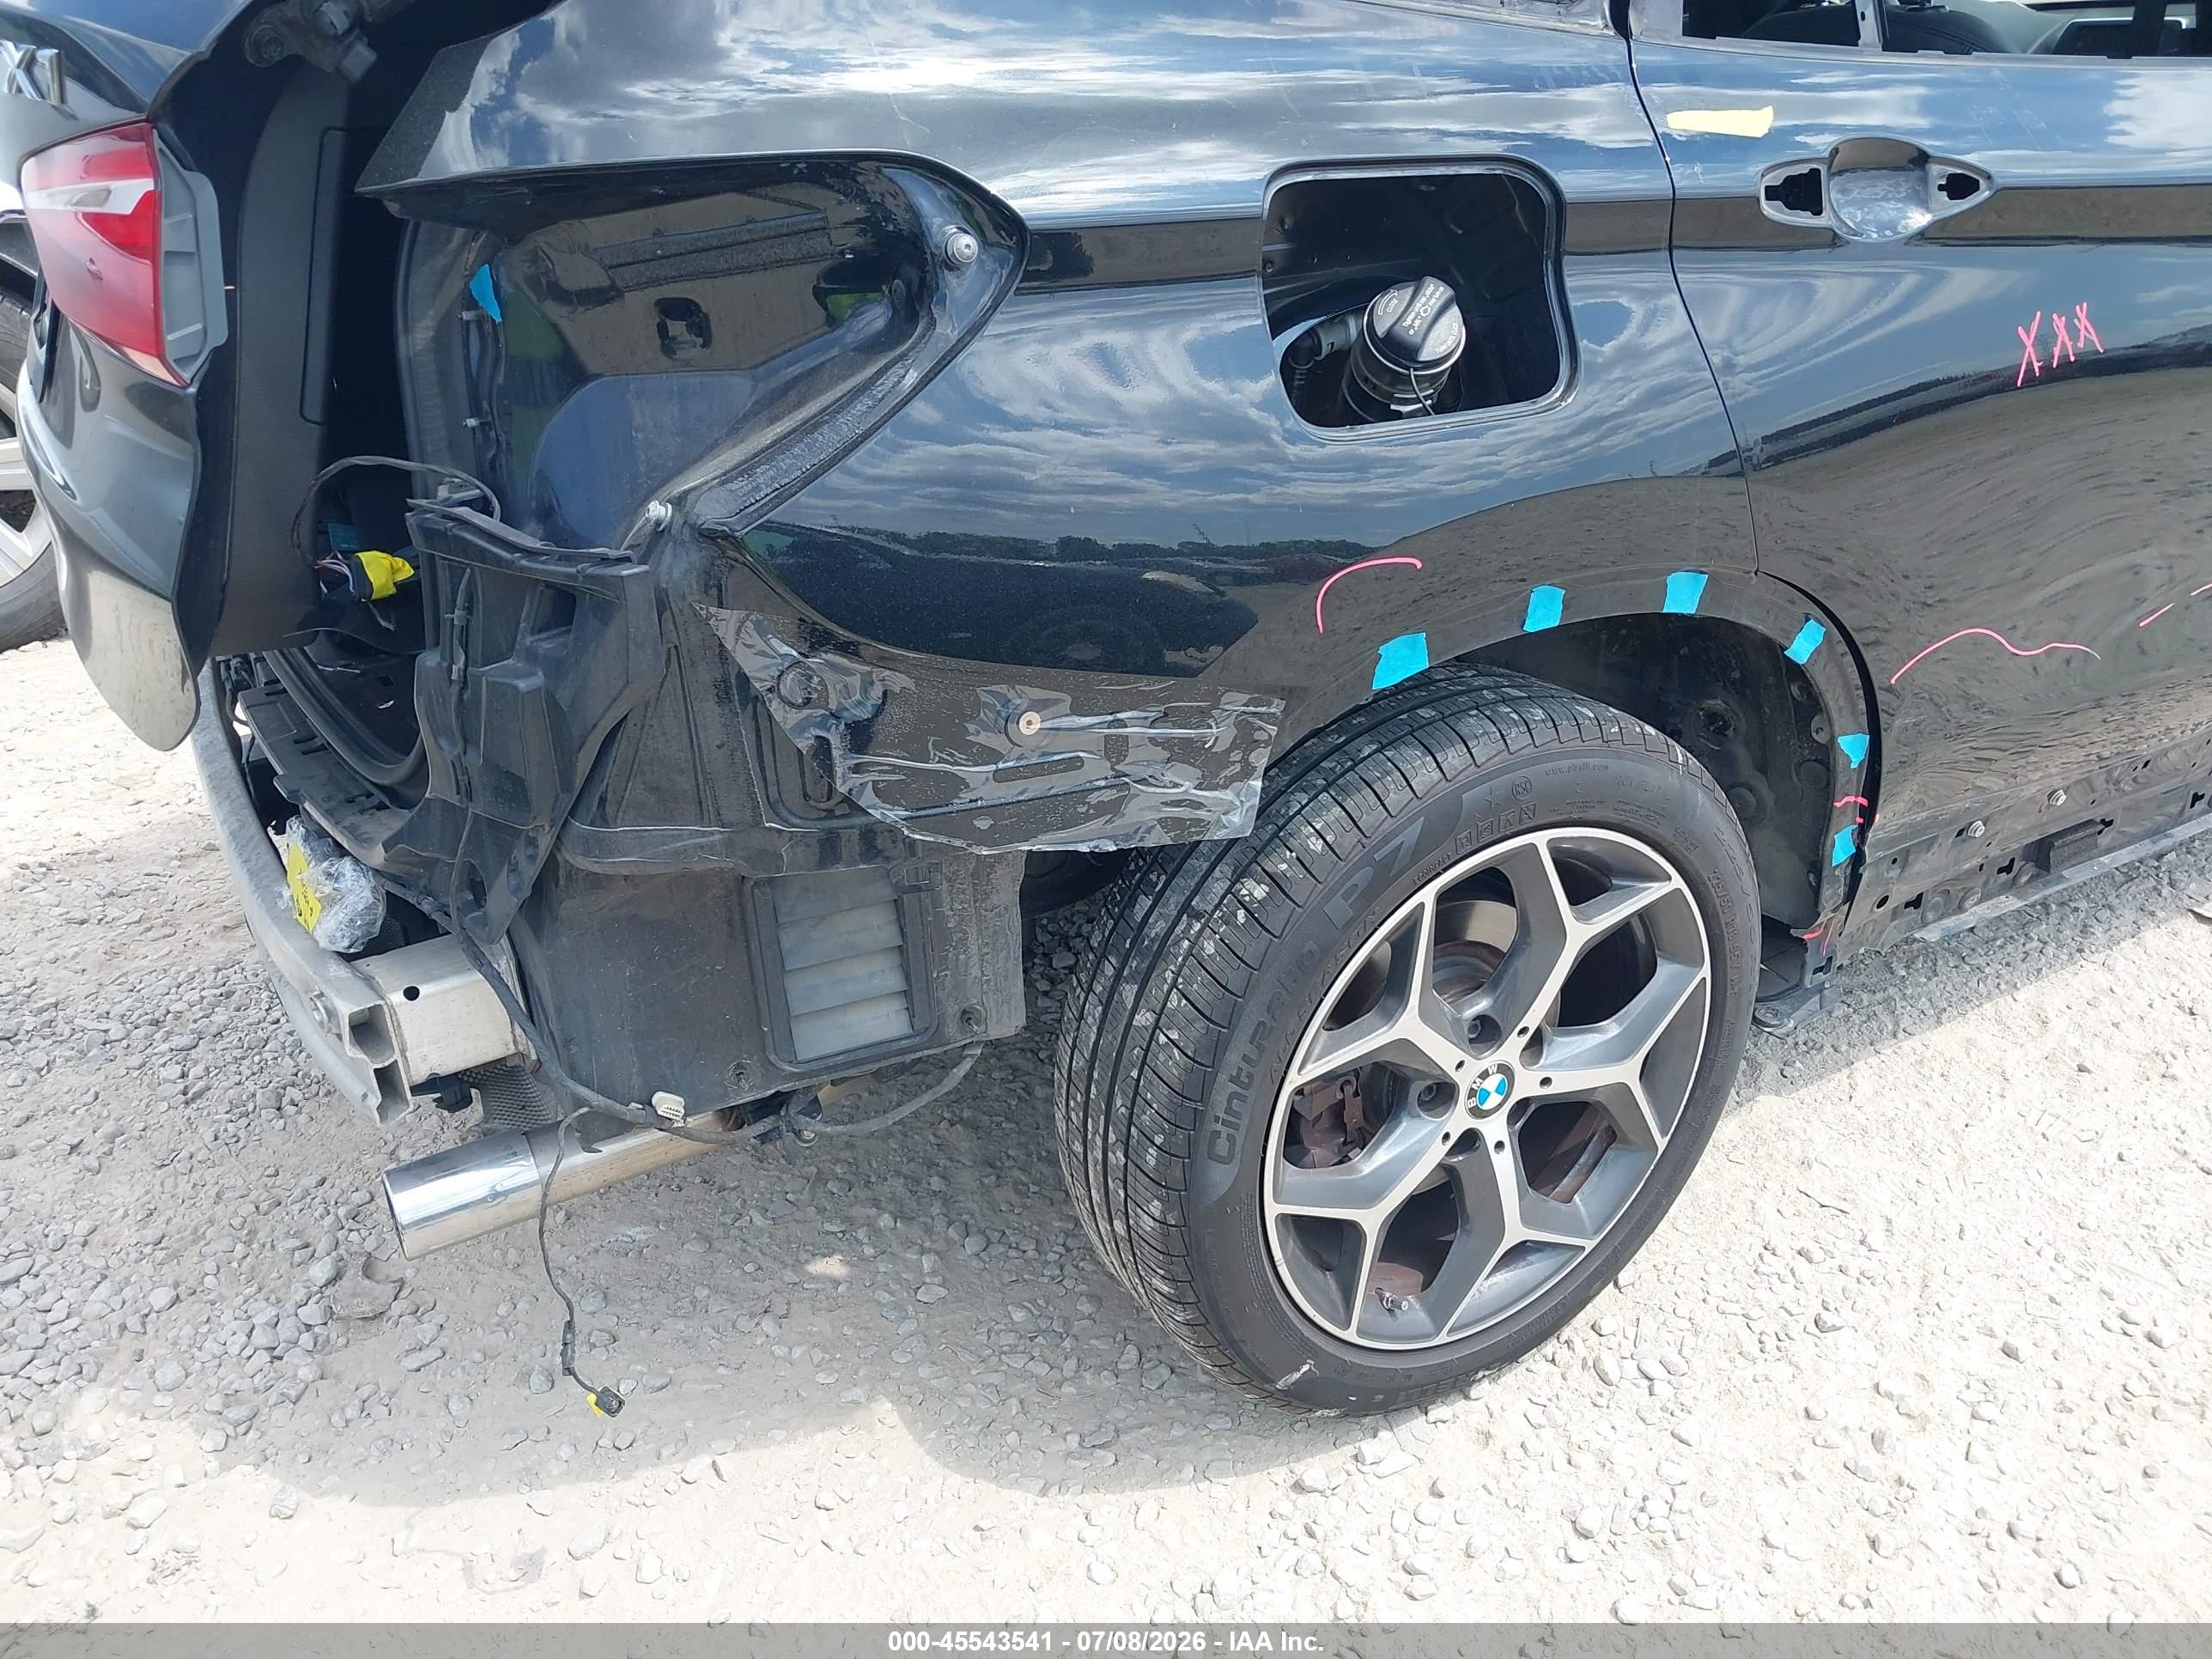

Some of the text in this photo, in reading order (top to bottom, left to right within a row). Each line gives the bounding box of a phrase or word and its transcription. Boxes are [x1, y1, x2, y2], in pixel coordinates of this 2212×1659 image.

[0, 40, 61, 105] X1
[1322, 817, 1425, 930] P7
[1468, 1064, 1498, 1109] BMW
